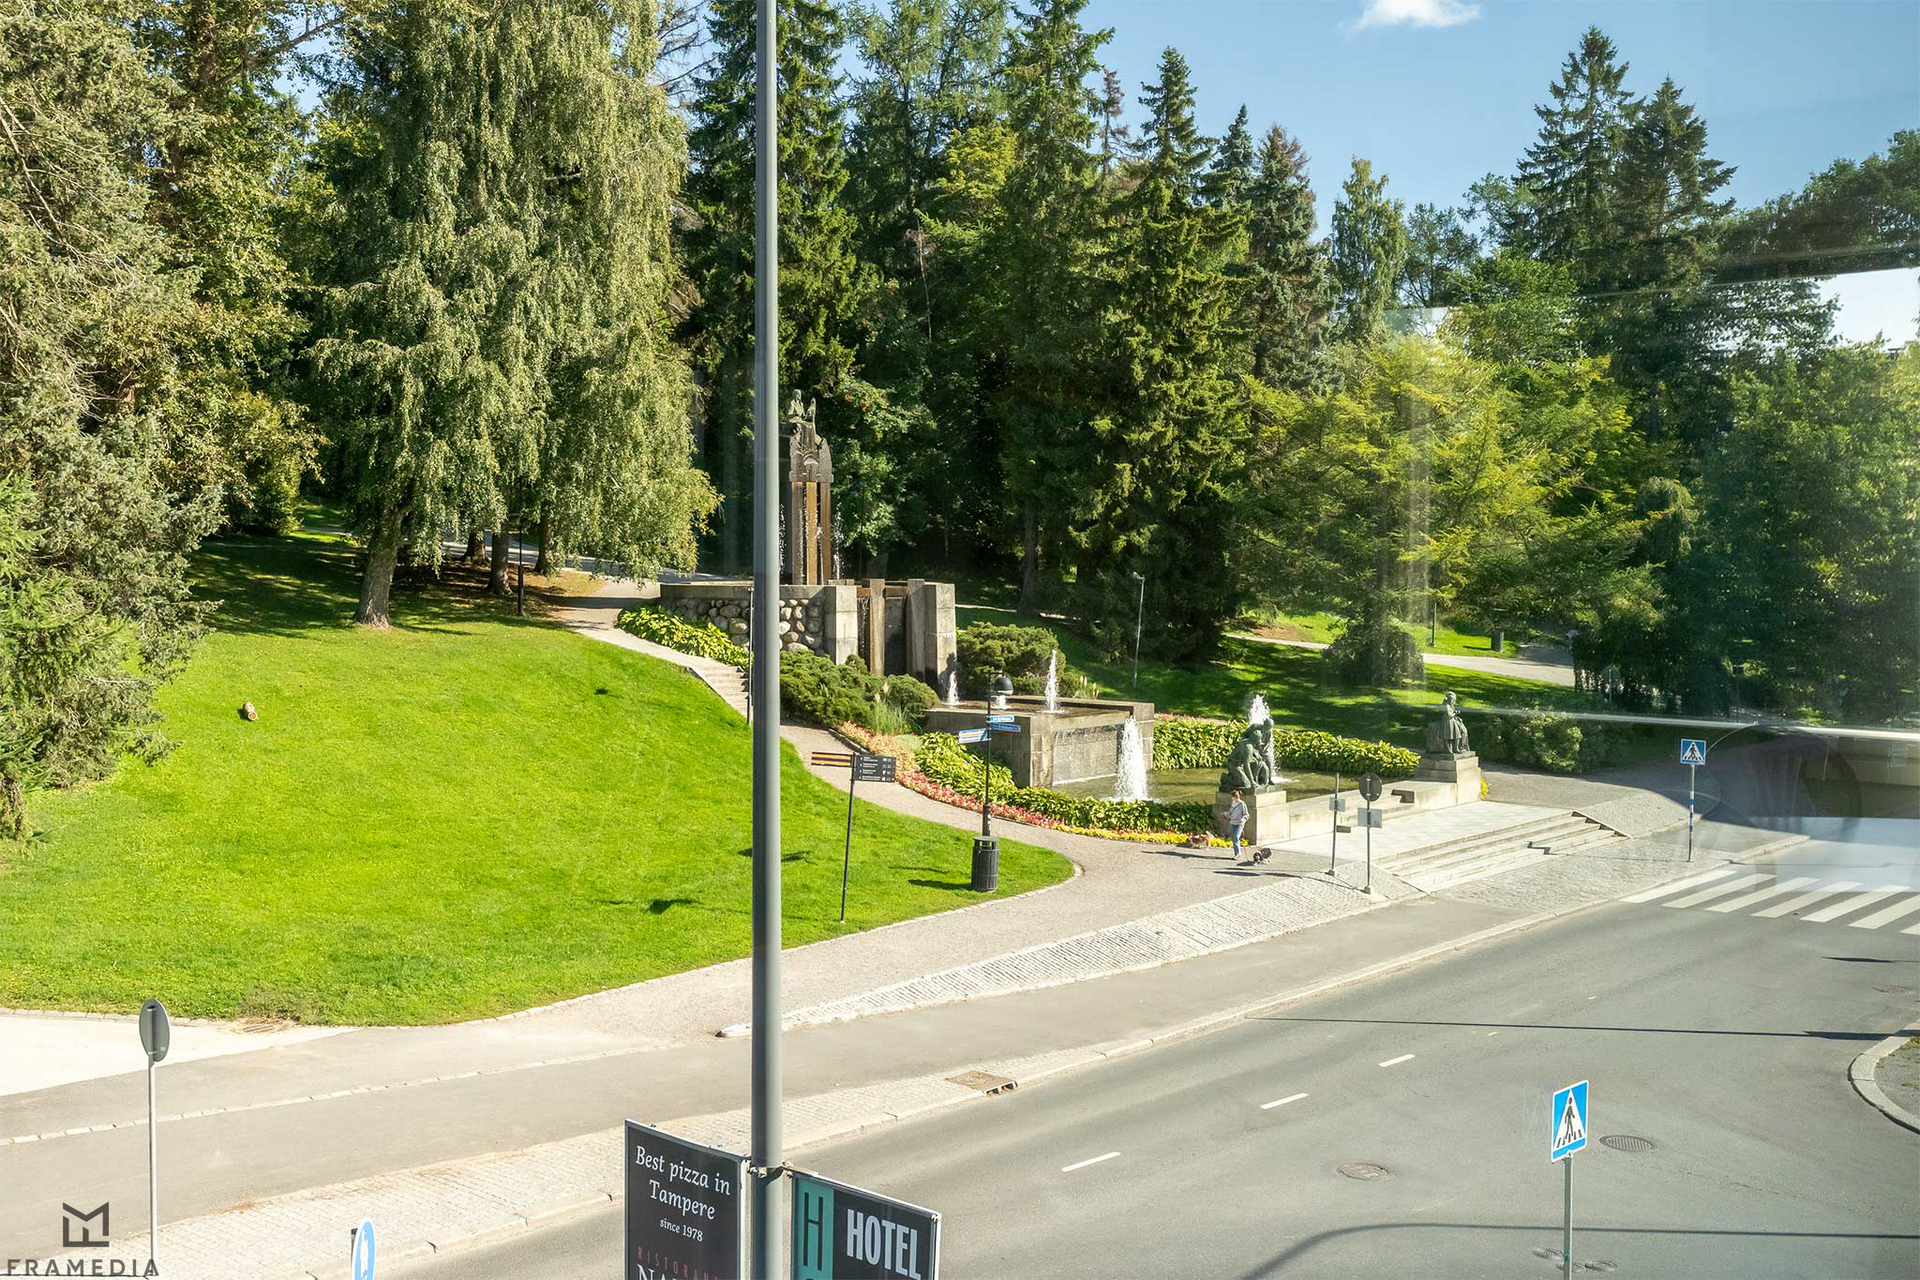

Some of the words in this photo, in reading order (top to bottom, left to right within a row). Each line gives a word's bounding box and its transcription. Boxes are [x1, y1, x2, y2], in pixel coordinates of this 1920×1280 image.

[635, 1145, 665, 1172] Best
[669, 1161, 709, 1188] pizza
[714, 1172, 731, 1195] in
[649, 1179, 715, 1220] Tampere
[659, 1218, 681, 1234] since
[682, 1225, 703, 1242] 1978
[846, 1208, 922, 1280] HOTEL
[636, 1246, 719, 1280] RISTORAN
